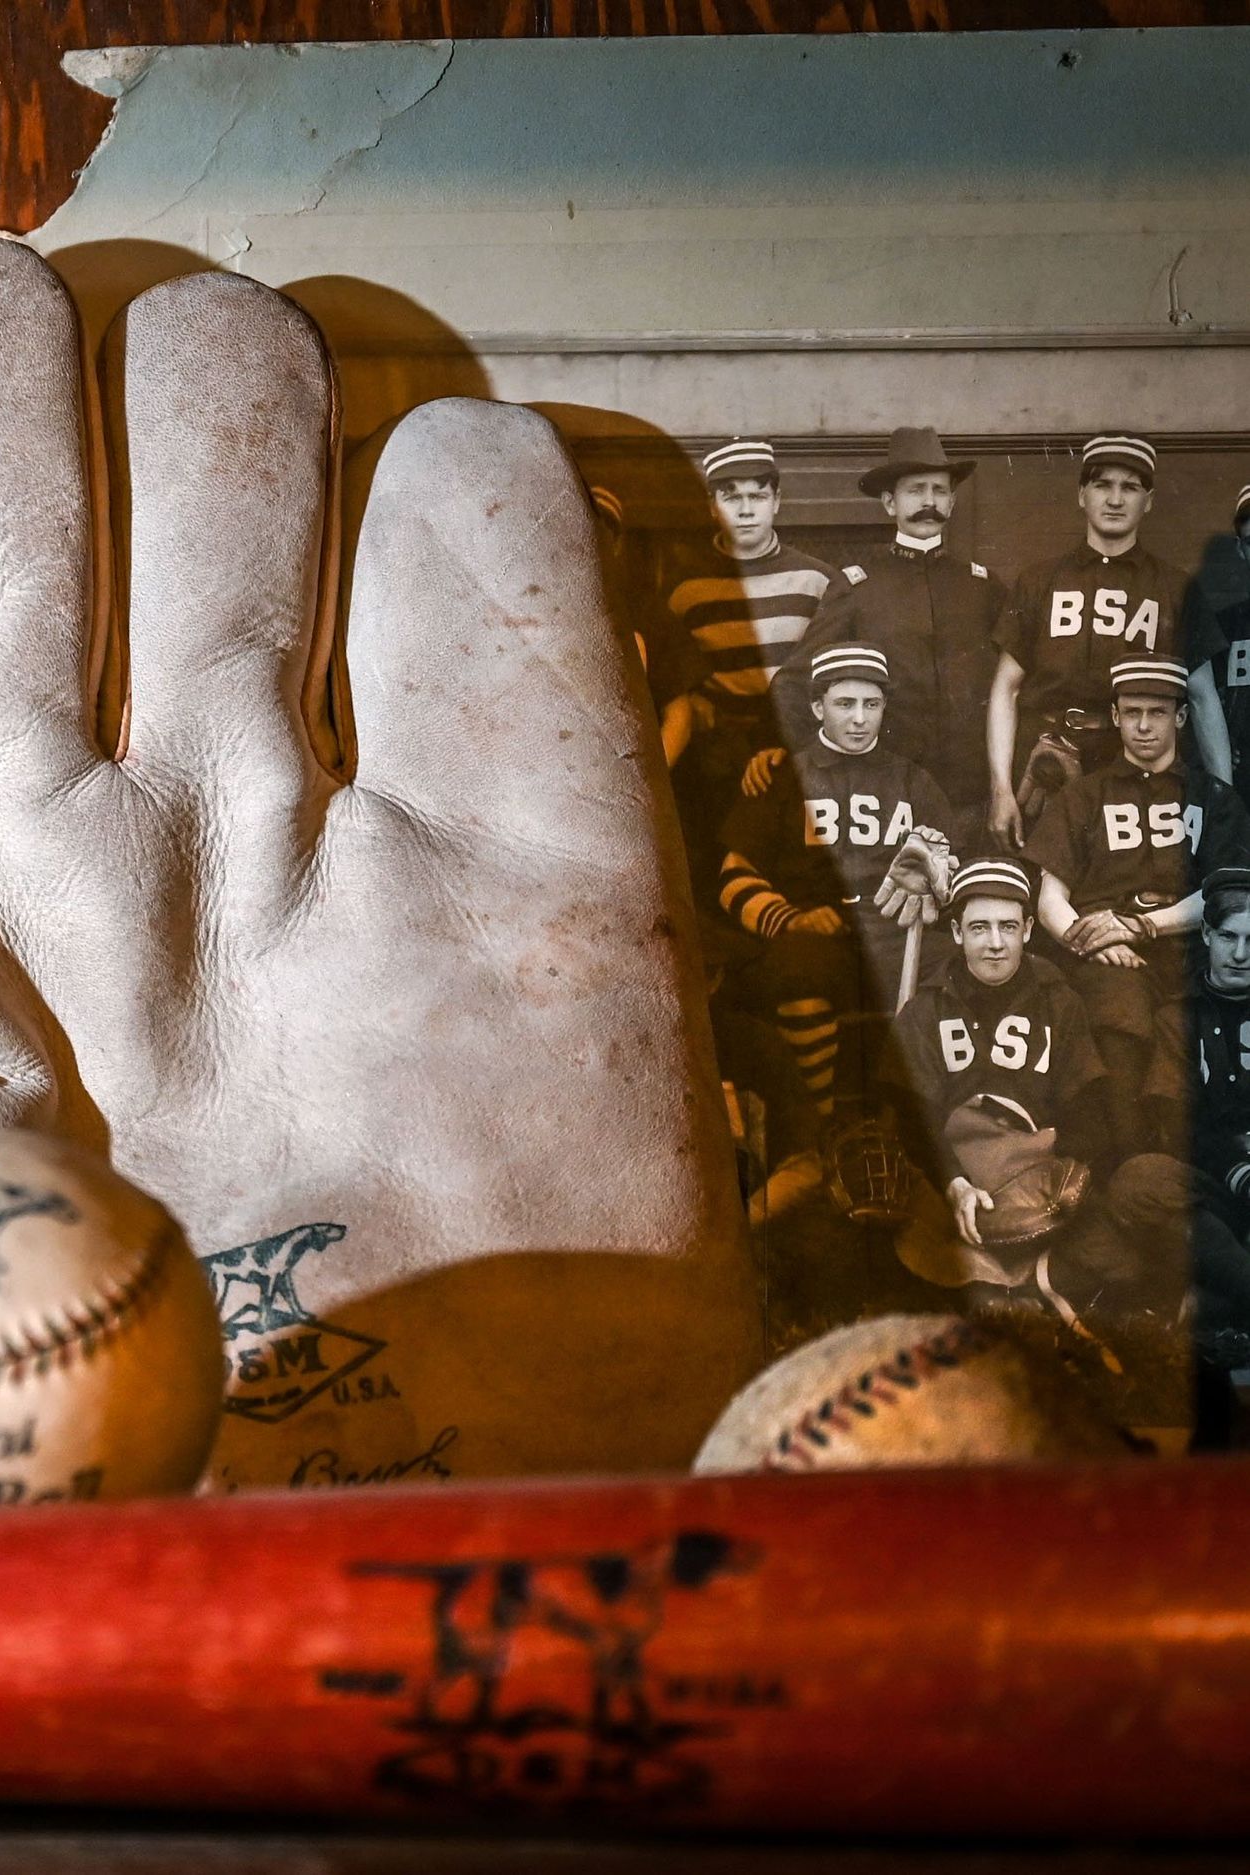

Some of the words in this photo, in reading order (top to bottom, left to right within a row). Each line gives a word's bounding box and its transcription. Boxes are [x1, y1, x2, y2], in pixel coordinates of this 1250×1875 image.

[1051, 588, 1159, 653] BSA
[805, 794, 913, 846] BSA
[1103, 802, 1203, 856] BSA
[224, 1332, 329, 1384] &M
